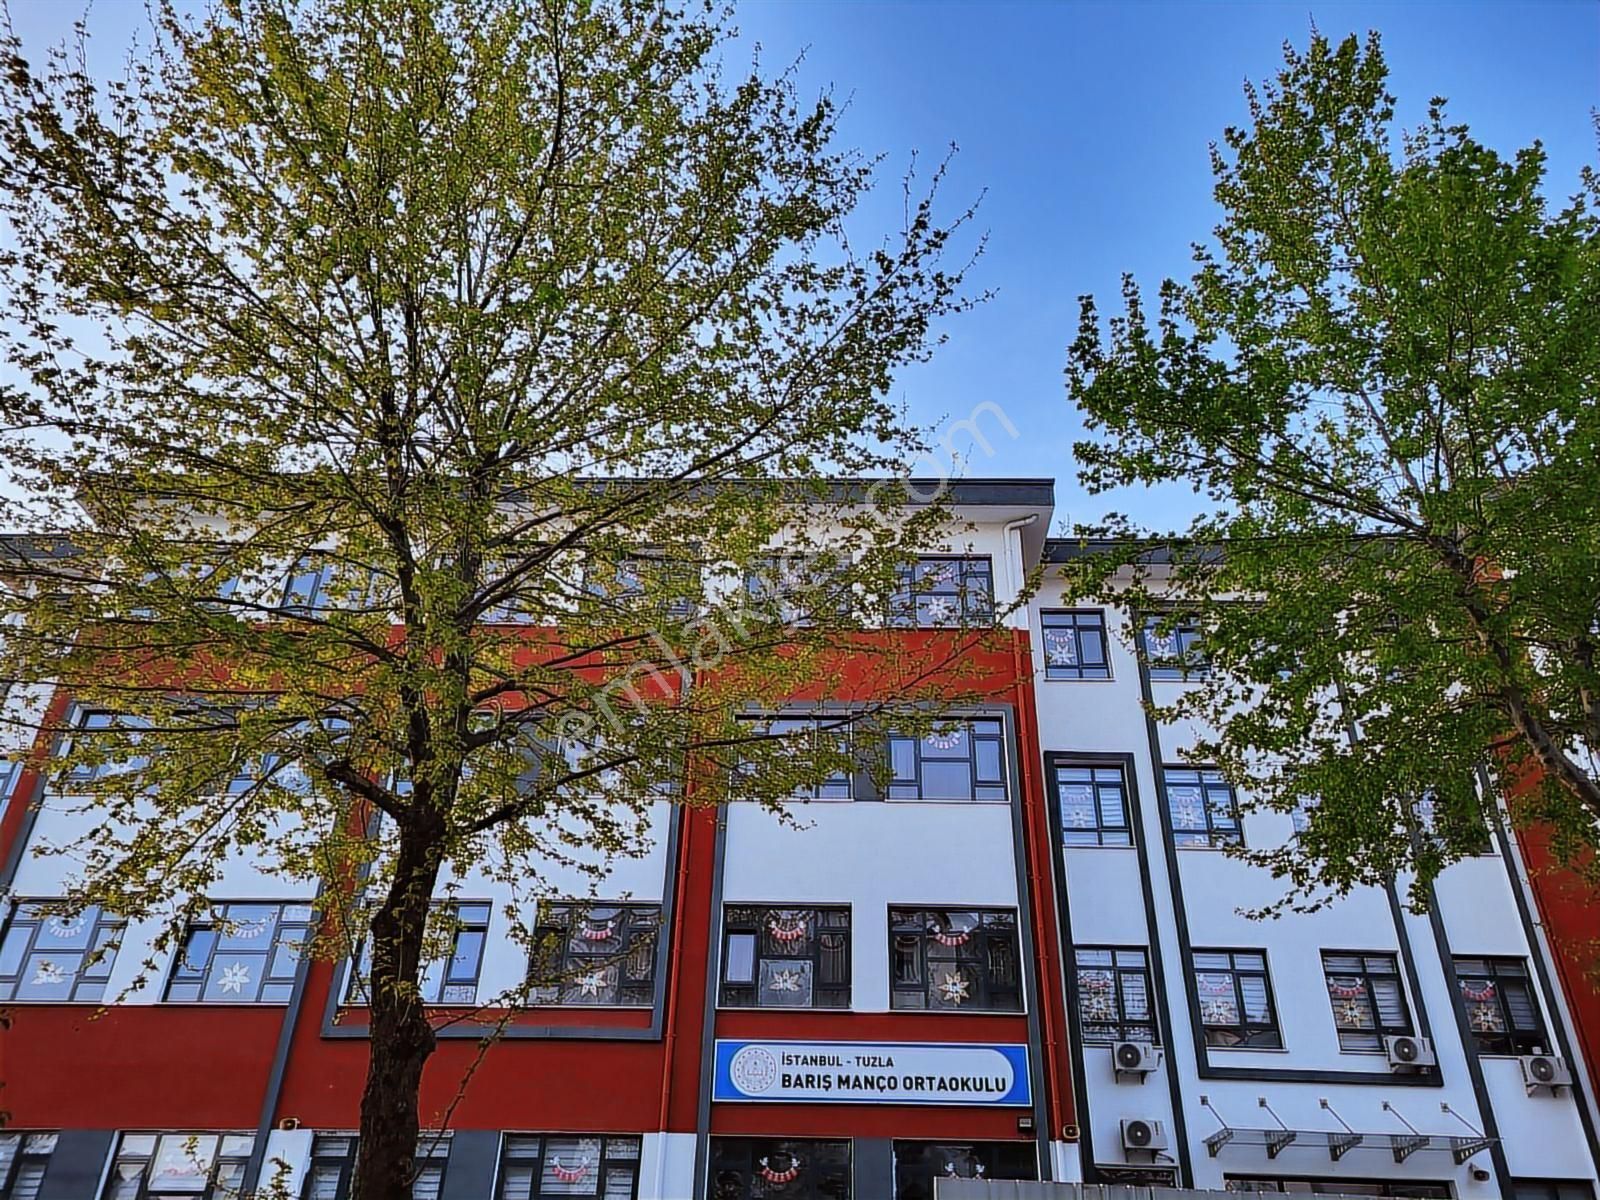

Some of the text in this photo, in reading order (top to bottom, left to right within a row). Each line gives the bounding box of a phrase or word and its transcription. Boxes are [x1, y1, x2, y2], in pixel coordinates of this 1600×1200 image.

[782, 1052, 843, 1067] İSTANBUL
[855, 1056, 894, 1068] TUZLA
[781, 1074, 1006, 1093] BARIŞ MANÇO ORTAOKULU
